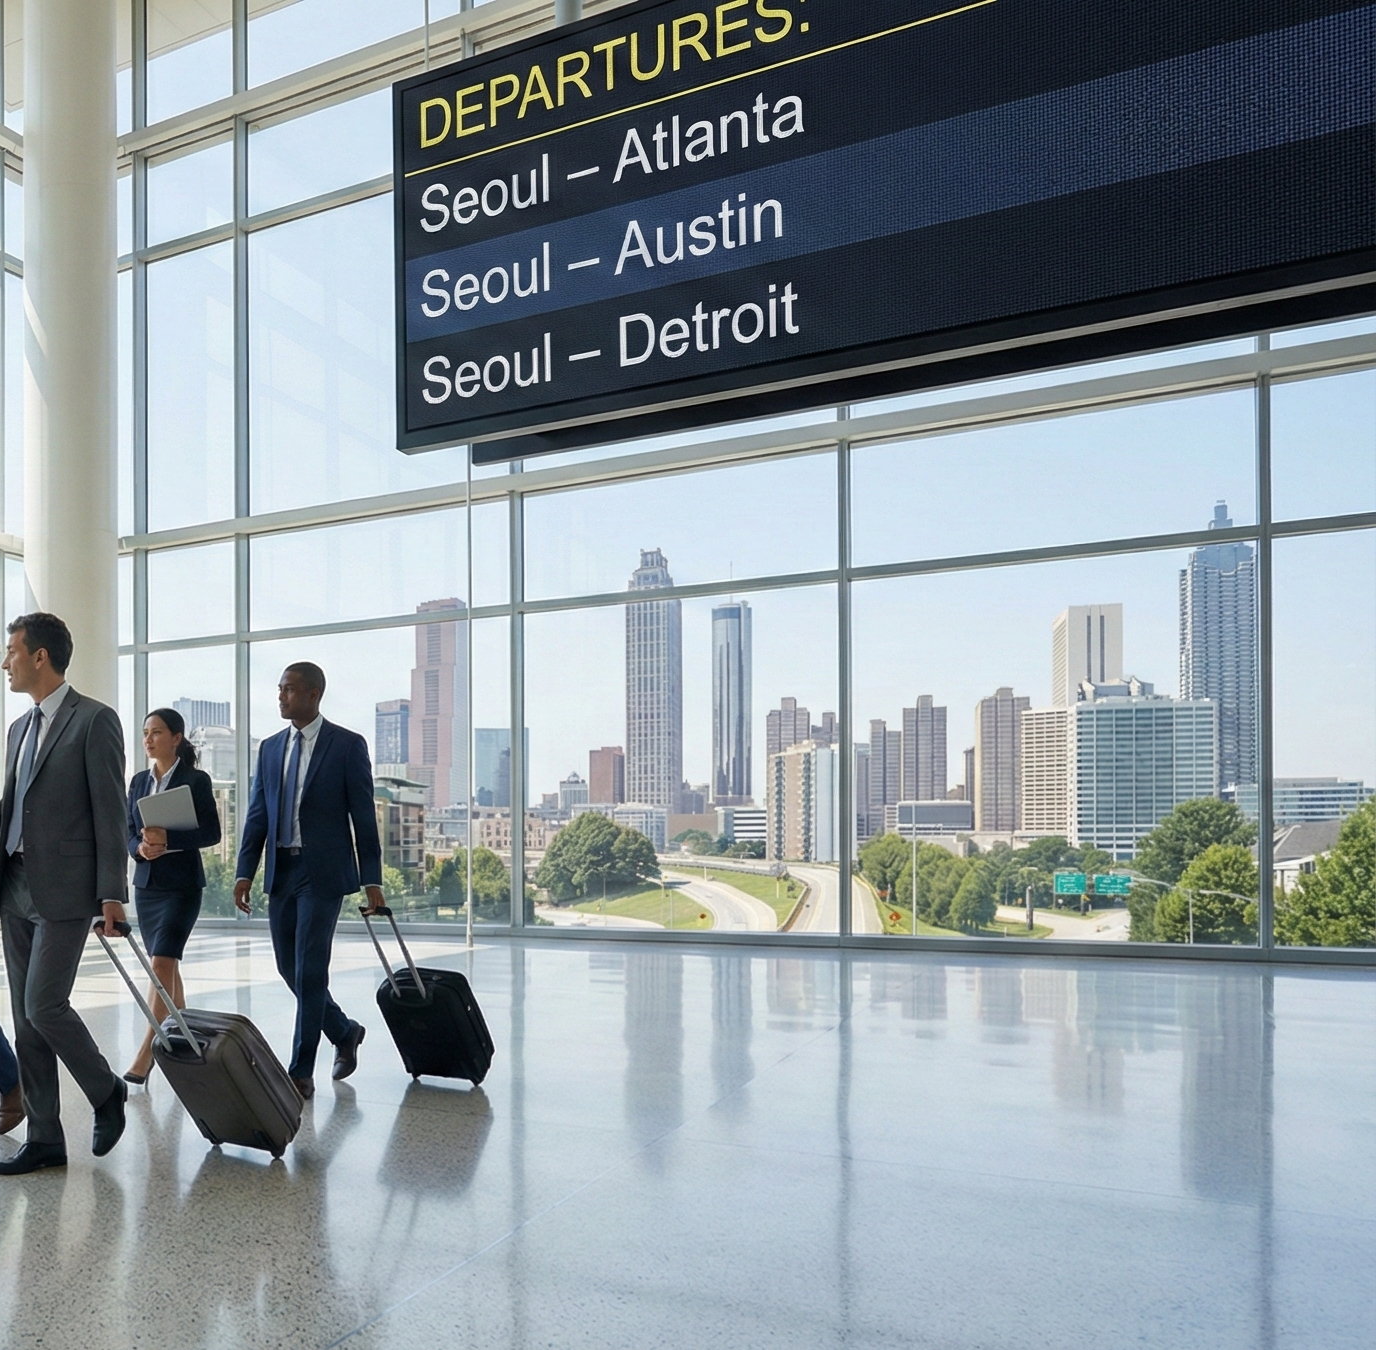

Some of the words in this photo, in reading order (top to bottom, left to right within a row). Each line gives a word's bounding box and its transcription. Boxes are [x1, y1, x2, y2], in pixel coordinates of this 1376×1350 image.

[420, 0, 809, 149] DEPARTURES:
[419, 153, 550, 233] Seoul
[612, 92, 805, 184] Atlanta
[420, 241, 550, 318] Seoul
[613, 192, 783, 276] Austin
[421, 332, 552, 405] Seoul
[619, 281, 800, 368] Detroit
